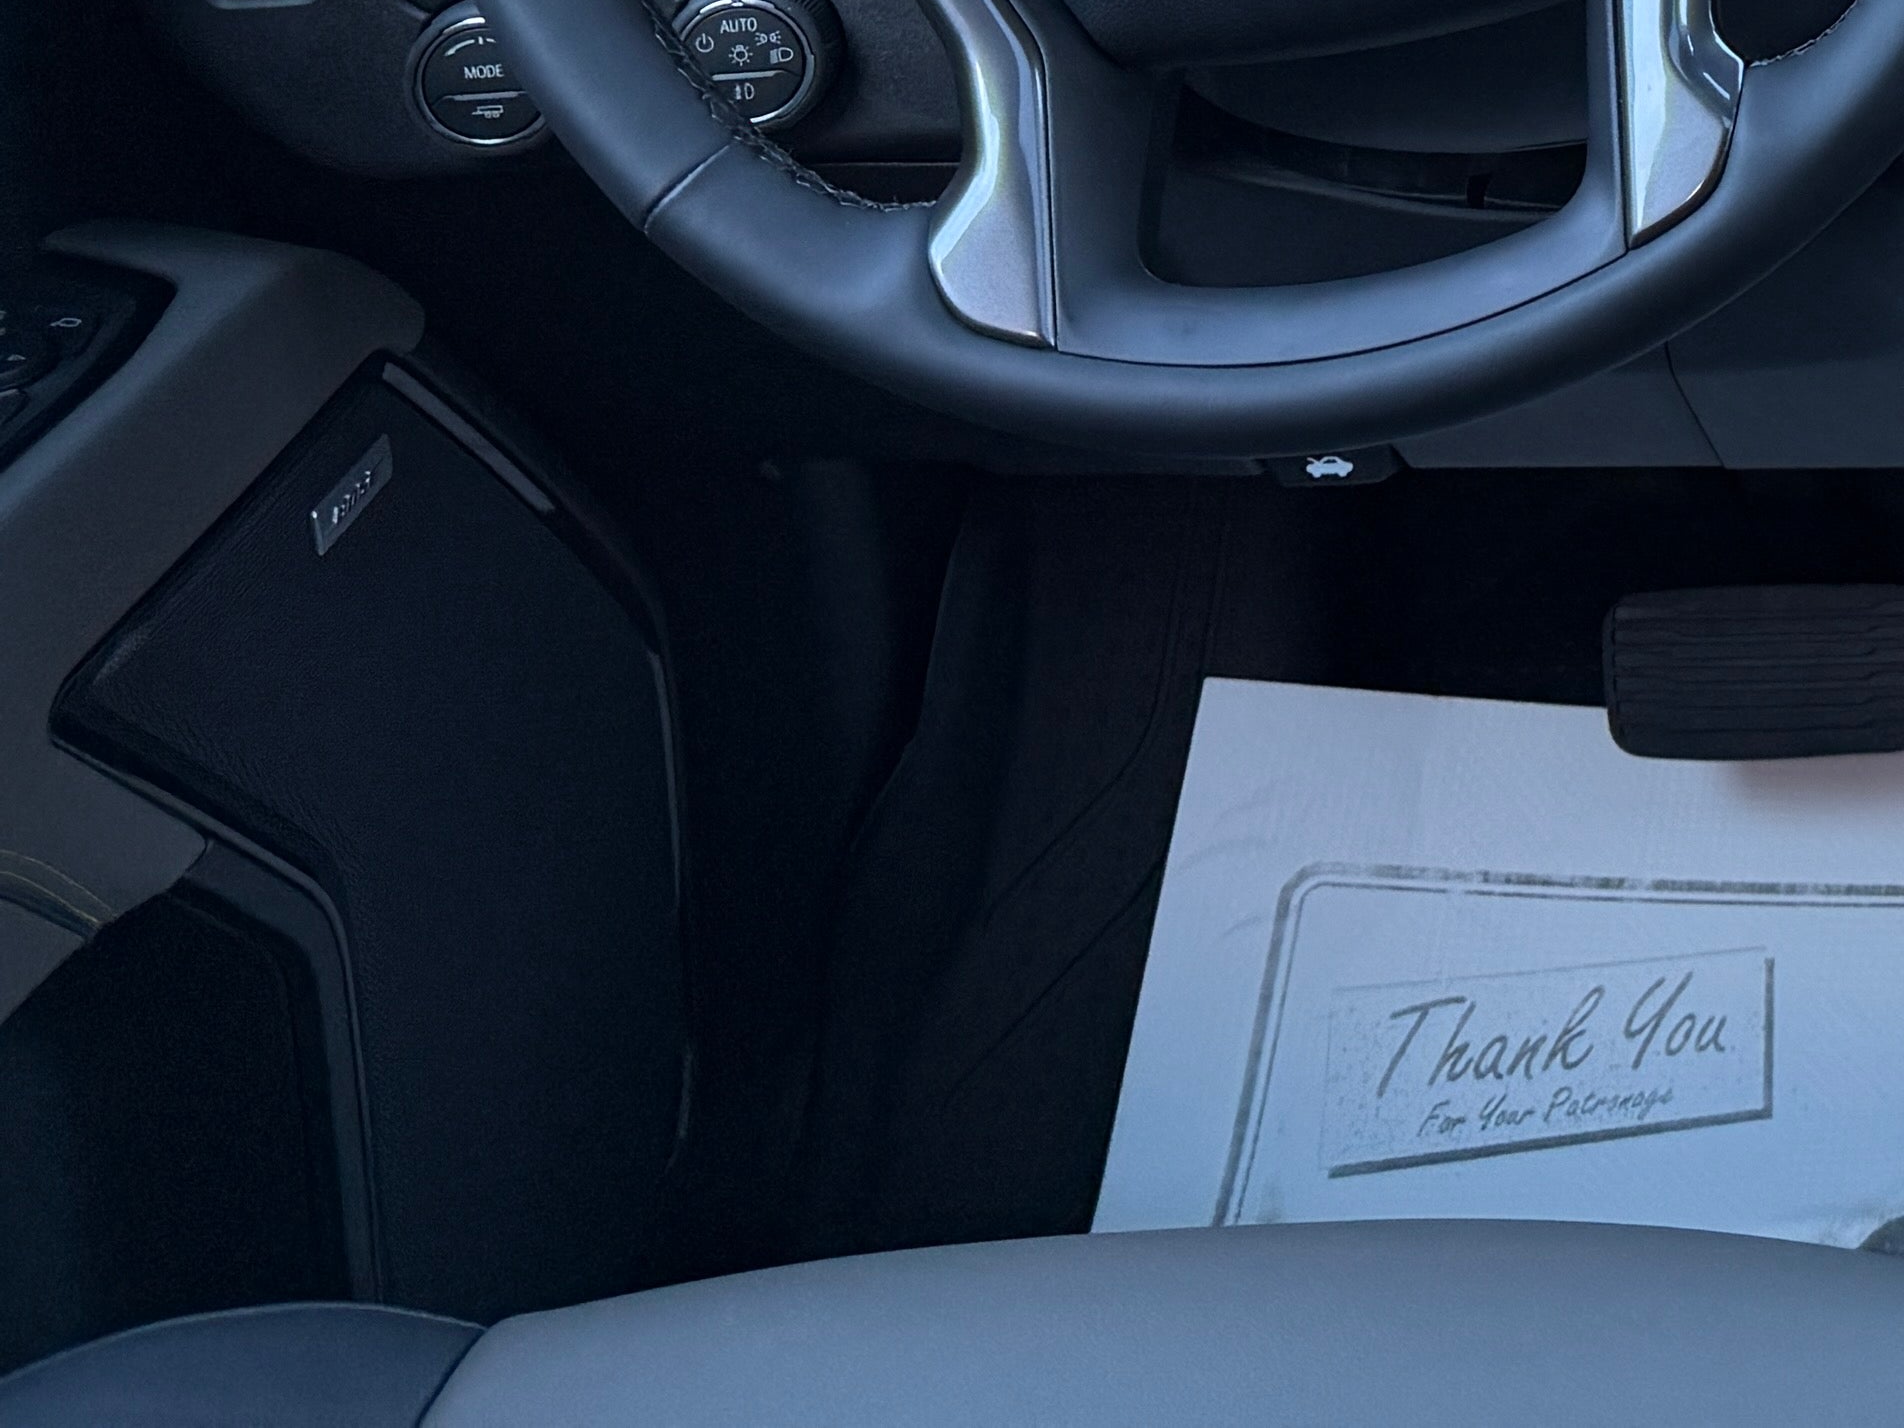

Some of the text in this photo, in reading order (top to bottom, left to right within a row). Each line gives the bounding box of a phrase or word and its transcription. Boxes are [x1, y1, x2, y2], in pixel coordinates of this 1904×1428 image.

[720, 17, 757, 33] AUTO
[464, 64, 505, 79] MODE
[1376, 971, 1728, 1099] Thank You
[1416, 1086, 1674, 1138] For Your Patronage
